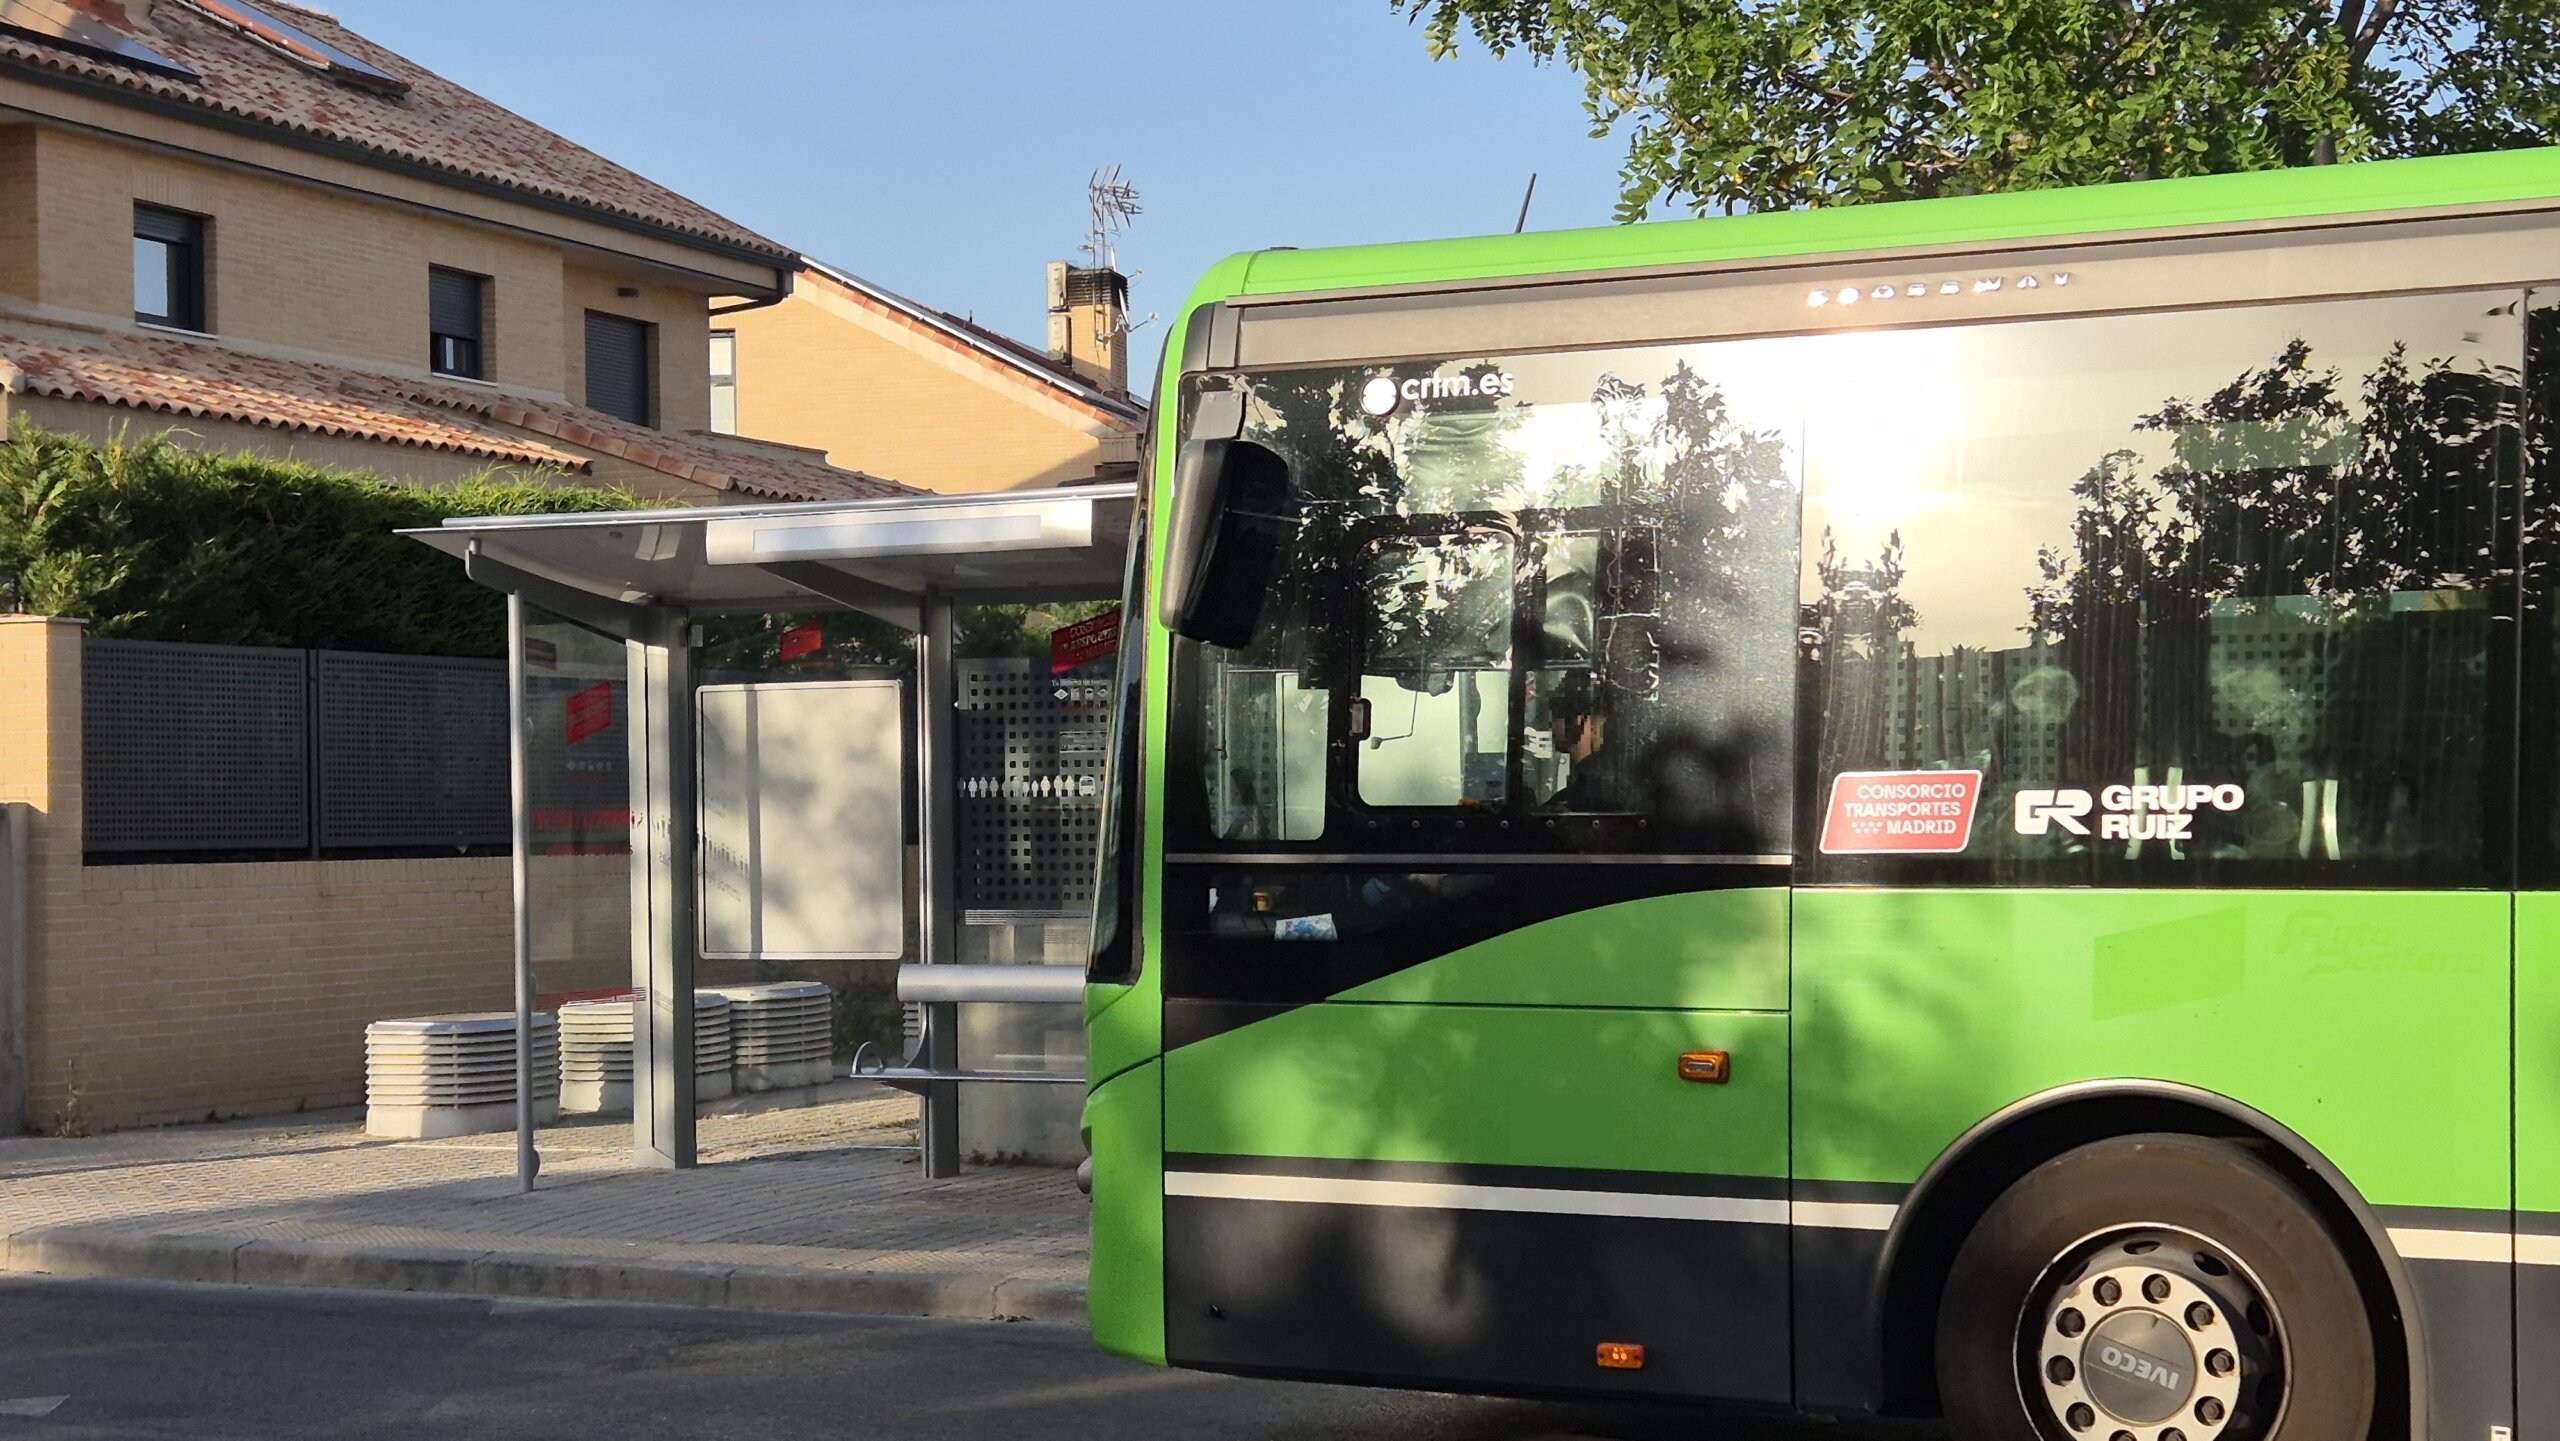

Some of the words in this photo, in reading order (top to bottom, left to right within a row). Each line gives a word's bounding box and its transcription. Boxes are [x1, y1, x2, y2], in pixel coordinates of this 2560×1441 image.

[1400, 371, 1514, 400] crtm.es
[1857, 783, 1966, 800] CONSORCIO
[2101, 784, 2245, 811] GRUPO
[1843, 801, 1961, 818] TRANSPORTES
[2014, 789, 2093, 835] GR
[1886, 819, 1957, 834] MADRID
[2101, 814, 2193, 840] RUIZ
[2101, 1346, 2179, 1391] IVECO
